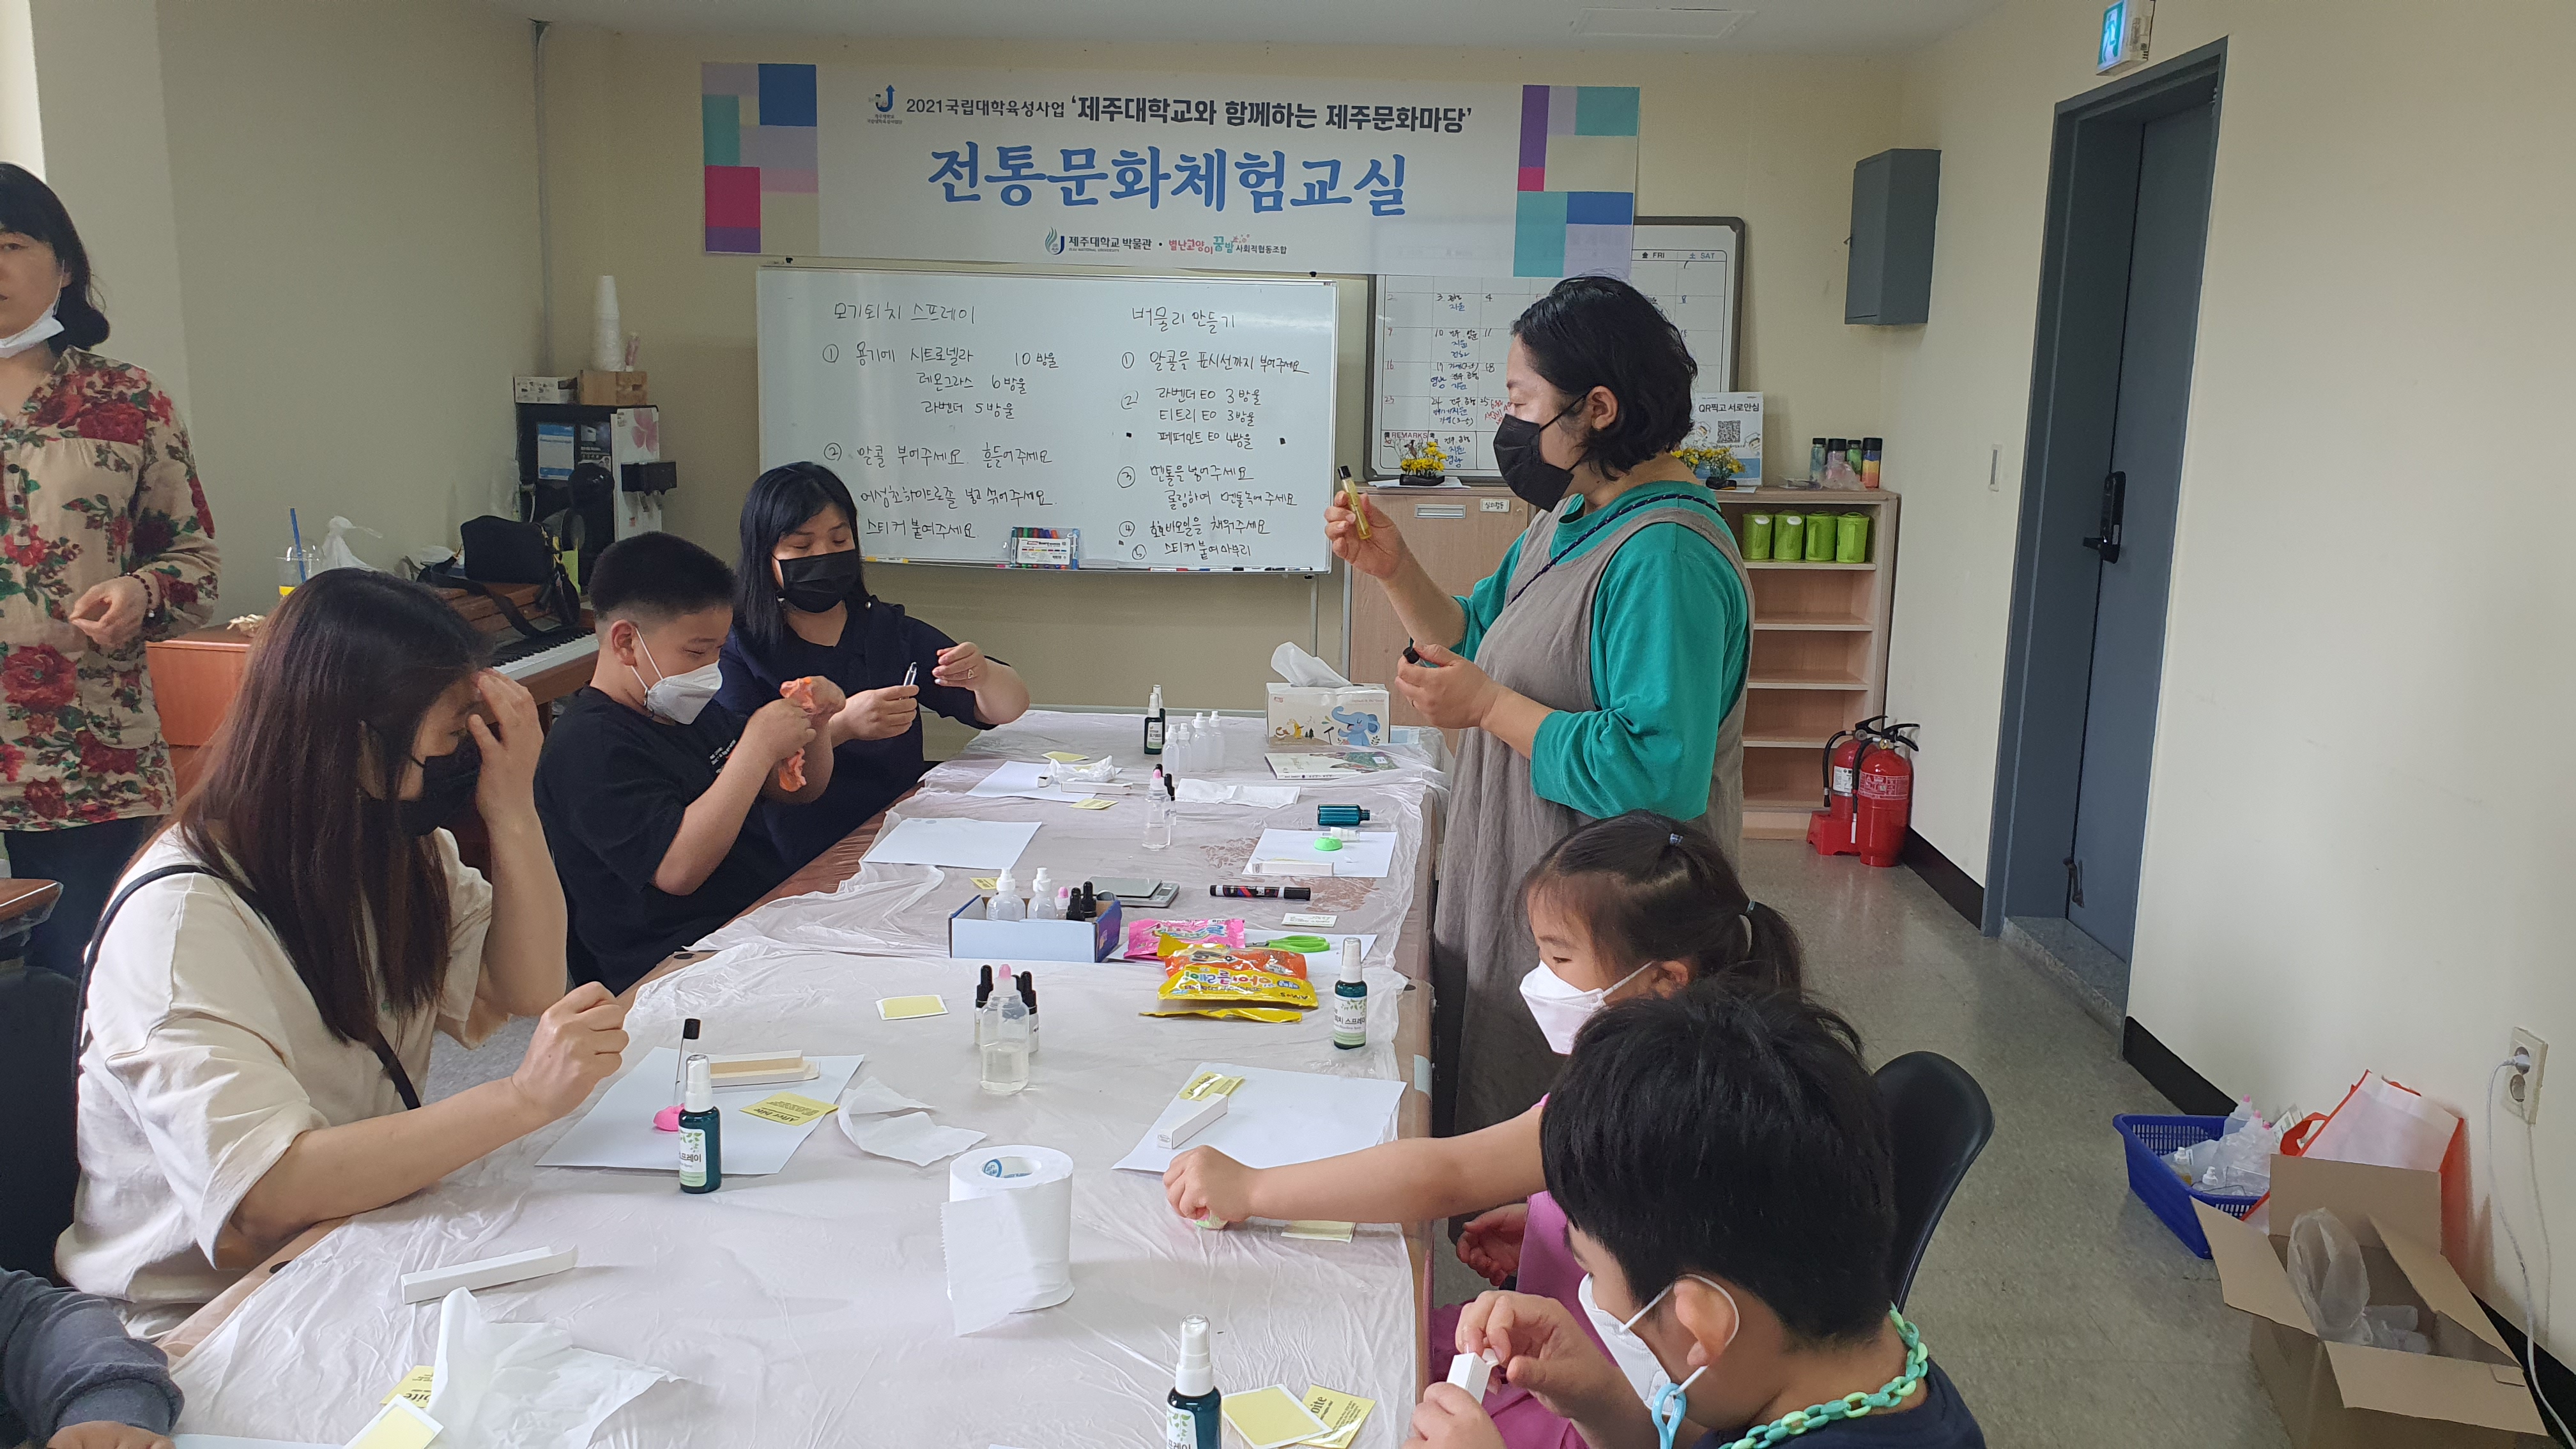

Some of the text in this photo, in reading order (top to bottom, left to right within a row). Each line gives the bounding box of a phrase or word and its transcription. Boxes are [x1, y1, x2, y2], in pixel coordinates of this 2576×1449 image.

[1225, 101, 1317, 128] 함께하는
[928, 141, 1406, 216] 전통문화체험교실
[1068, 236, 1120, 247] 제주대학교
[1123, 238, 1152, 250] 박물관
[1682, 295, 1687, 303] 8
[834, 301, 974, 325] 모기퇴치 스프레이
[1132, 306, 1235, 334] 버물리 만들기
[1435, 328, 1443, 337] 10
[855, 341, 895, 366] 용기에
[910, 346, 974, 365] 시트로넬라
[1015, 352, 1031, 367] 10
[1036, 352, 1059, 369] 방울
[1149, 349, 1190, 372] 알콜을
[1196, 351, 1254, 371] 표시선까지
[1260, 355, 1310, 374] 부어주세요
[1155, 387, 1195, 403] 라벤더
[1200, 389, 1216, 399] EO
[1431, 397, 1442, 408] 24
[921, 401, 963, 414] 라벤더
[1699, 403, 1759, 412] QR찍고 서로안심
[1159, 408, 1196, 424] 티트리
[1201, 410, 1217, 421] EO
[1156, 430, 1204, 445] 페퍼민트
[1208, 431, 1220, 441] EO
[856, 445, 885, 468] 알콜
[981, 441, 1053, 468] 흔들어주세요
[1149, 464, 1184, 487] 멘톨을
[1188, 464, 1255, 482] 넣어주세요
[866, 518, 906, 536] 스티커
[1209, 515, 1271, 535] 채워주세요
[1164, 541, 1195, 555] 스티커
[680, 1152, 702, 1162] 프레이
